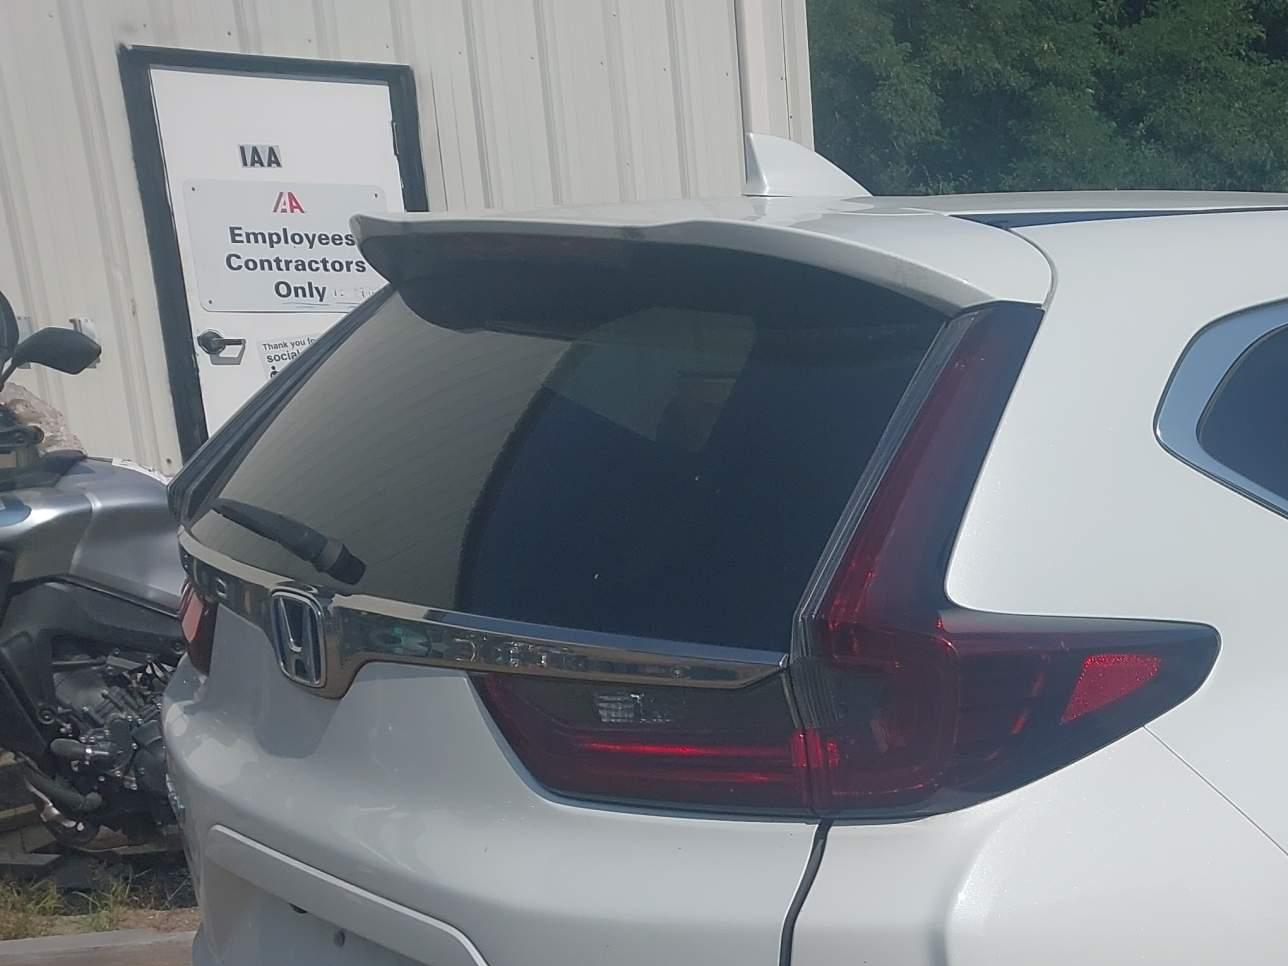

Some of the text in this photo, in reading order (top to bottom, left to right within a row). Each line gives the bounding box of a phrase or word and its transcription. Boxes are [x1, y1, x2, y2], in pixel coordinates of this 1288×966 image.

[239, 145, 282, 168] IAA
[228, 226, 356, 249] Employees
[225, 253, 367, 273] Contractors
[274, 281, 327, 302] Only
[262, 341, 289, 351] Thank
[290, 340, 306, 349] you
